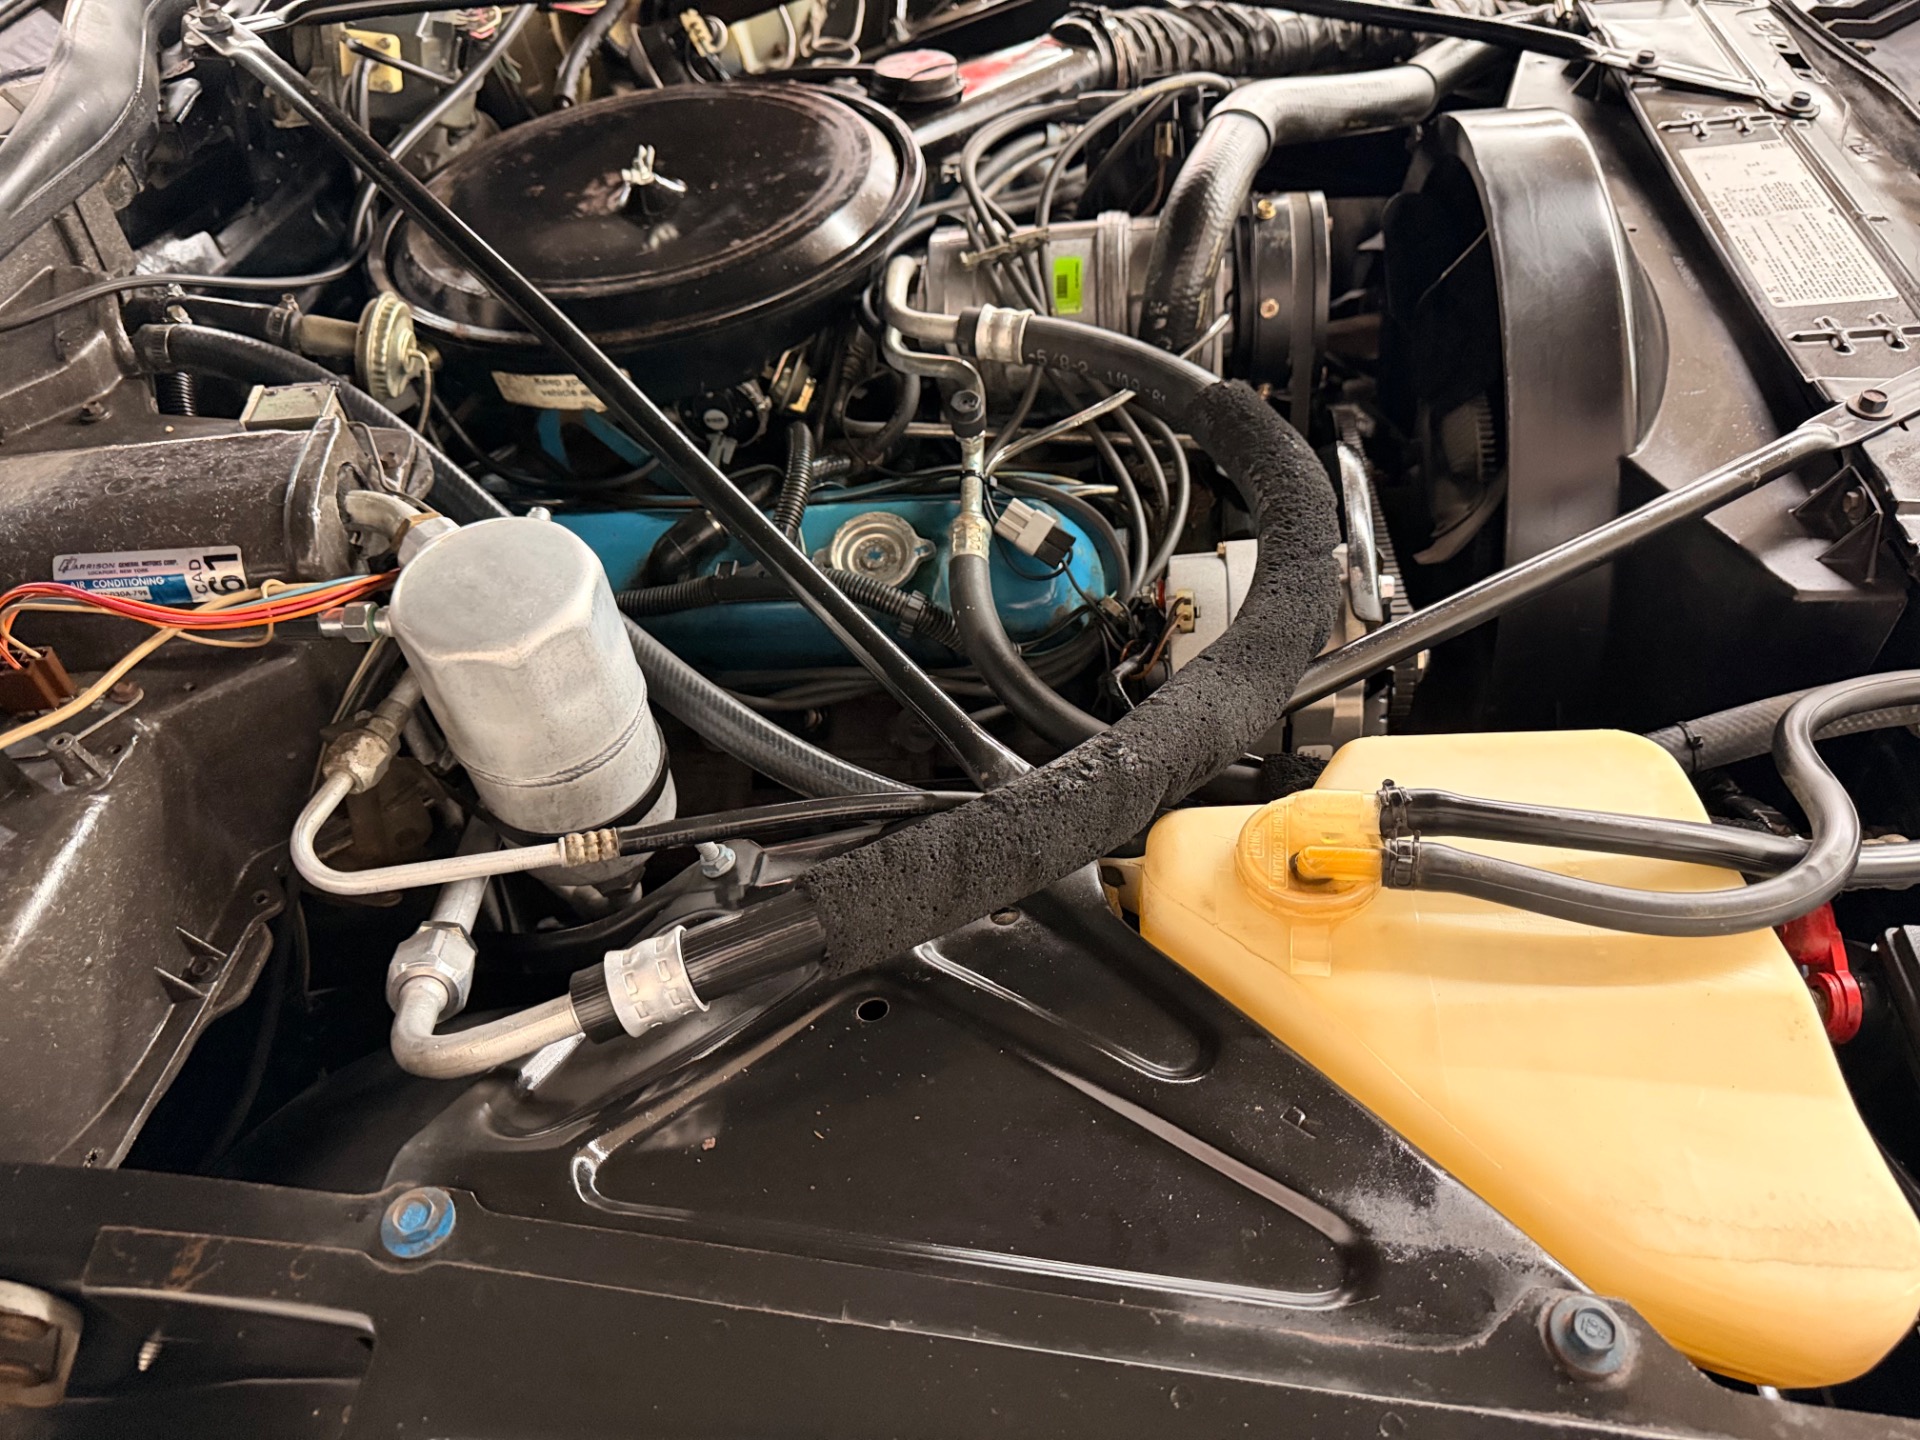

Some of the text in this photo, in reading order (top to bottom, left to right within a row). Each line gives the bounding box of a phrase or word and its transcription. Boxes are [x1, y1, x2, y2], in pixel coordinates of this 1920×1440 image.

[540, 389, 577, 397] vehicle
[118, 561, 139, 569] GENERAL
[189, 559, 208, 595] CAD
[203, 553, 246, 596] 61
[69, 576, 165, 590] AIR CONDITIONING
[635, 830, 697, 848] PARKER
[1248, 827, 1261, 857] ONLY
[1273, 806, 1285, 883] ENGINE COOLANT
